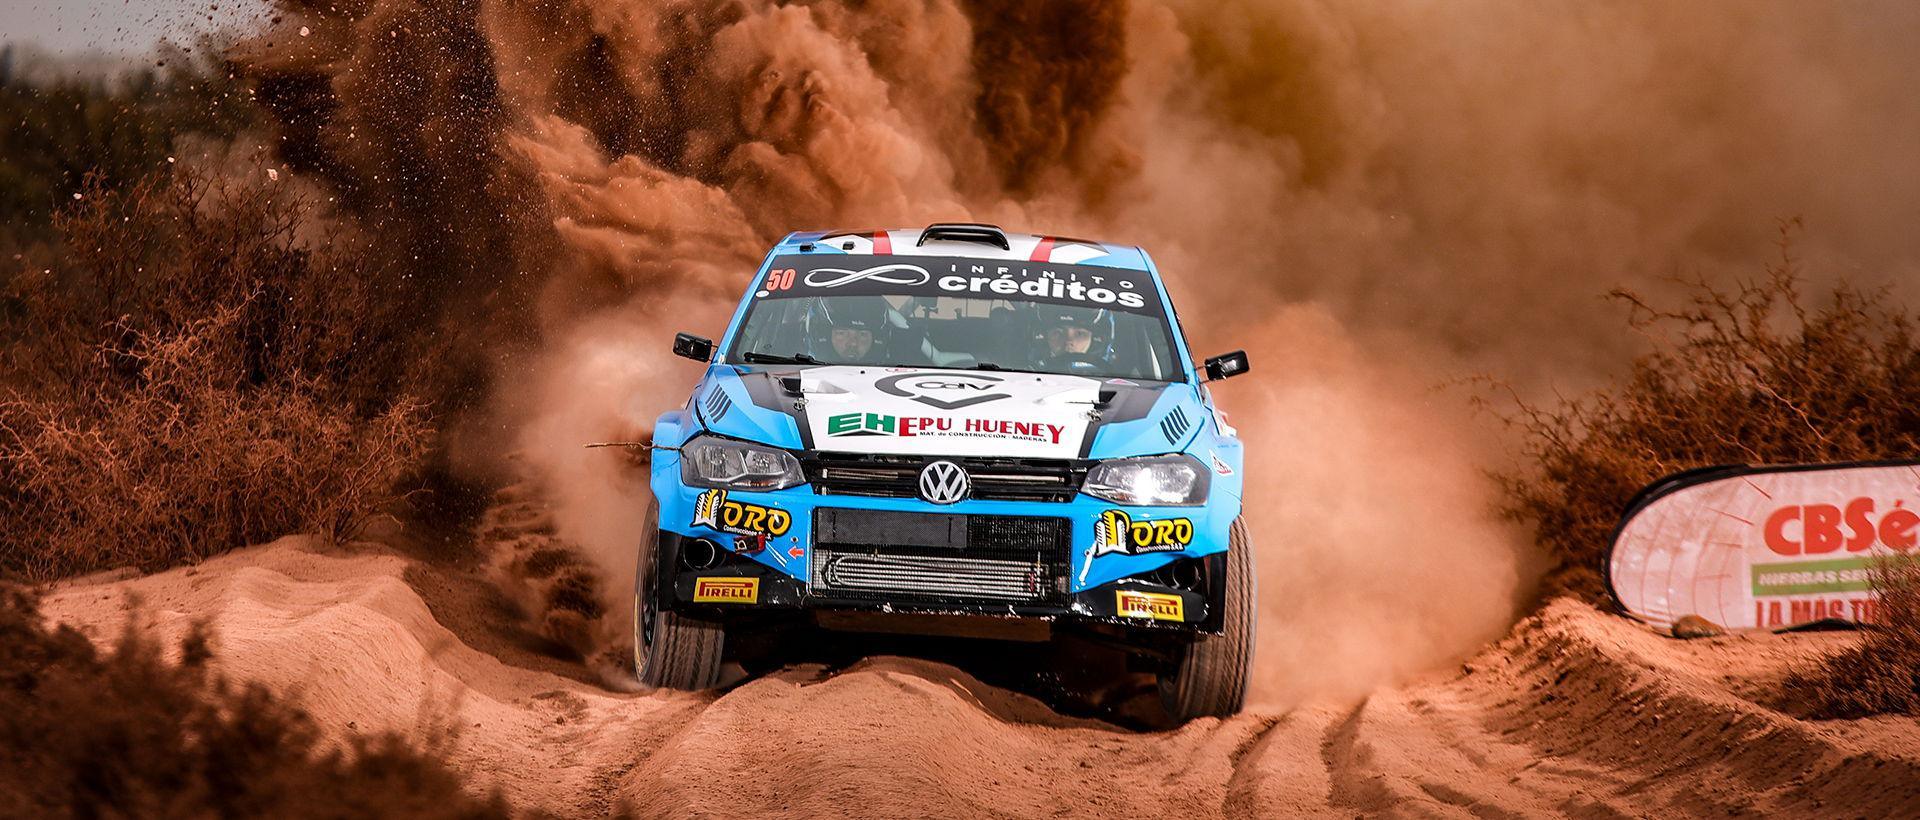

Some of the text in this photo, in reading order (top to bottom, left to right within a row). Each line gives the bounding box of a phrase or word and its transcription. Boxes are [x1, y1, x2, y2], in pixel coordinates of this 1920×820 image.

[766, 268, 797, 292] 50
[951, 264, 1135, 290] INFINITO
[937, 275, 1146, 309] créditos
[965, 417, 1065, 444] HUENEY
[1764, 496, 1920, 556] CBSé
[699, 582, 754, 598] PIRELLI
